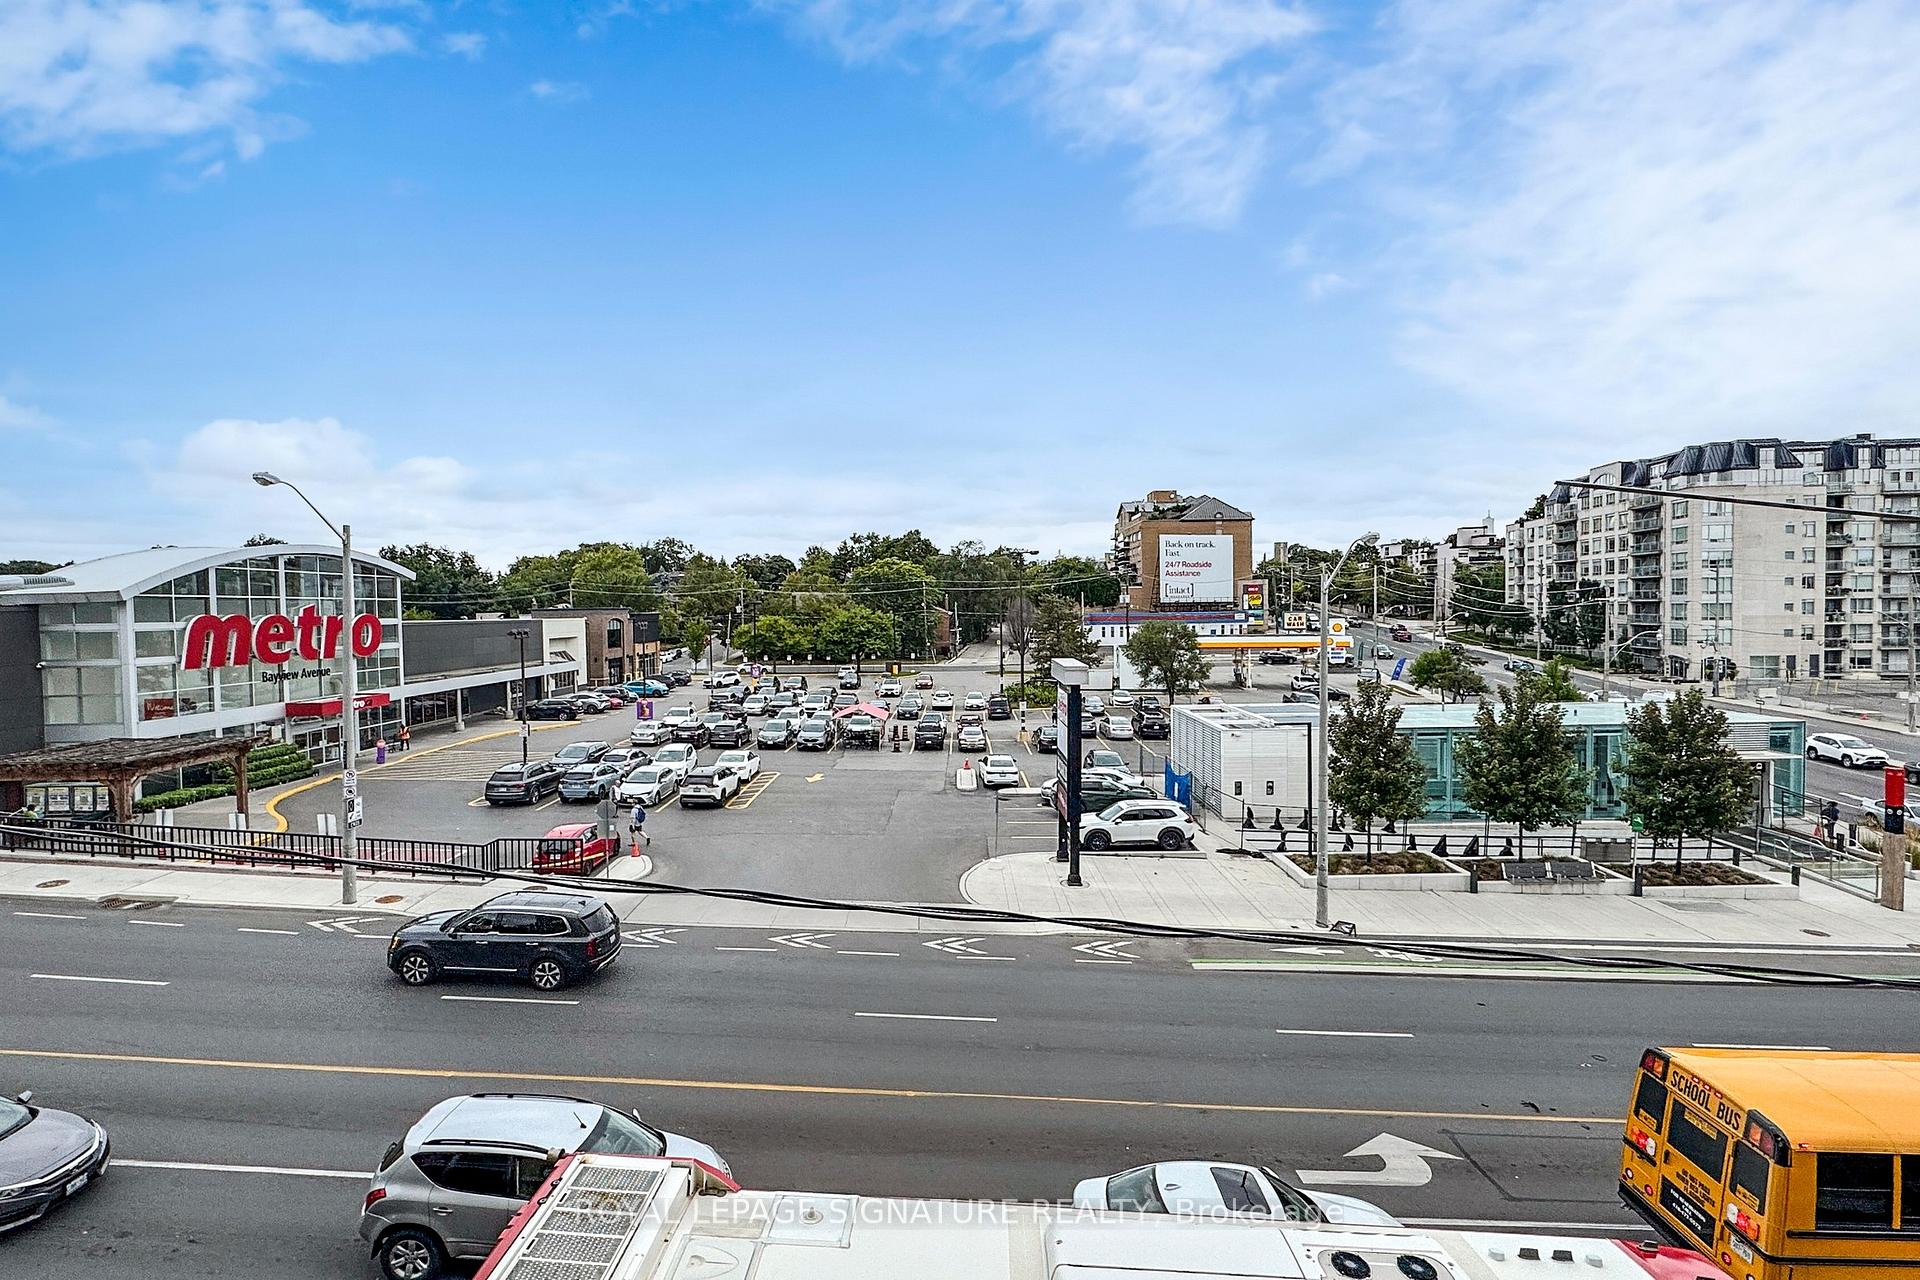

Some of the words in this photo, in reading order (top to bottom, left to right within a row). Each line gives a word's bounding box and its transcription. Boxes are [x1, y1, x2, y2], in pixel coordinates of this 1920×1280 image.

[181, 603, 383, 670] metro
[262, 671, 299, 684] Bayview
[301, 667, 331, 679] Avenue
[1671, 1070, 1711, 1112] SCHOOL
[1716, 1101, 1741, 1130] BUS
